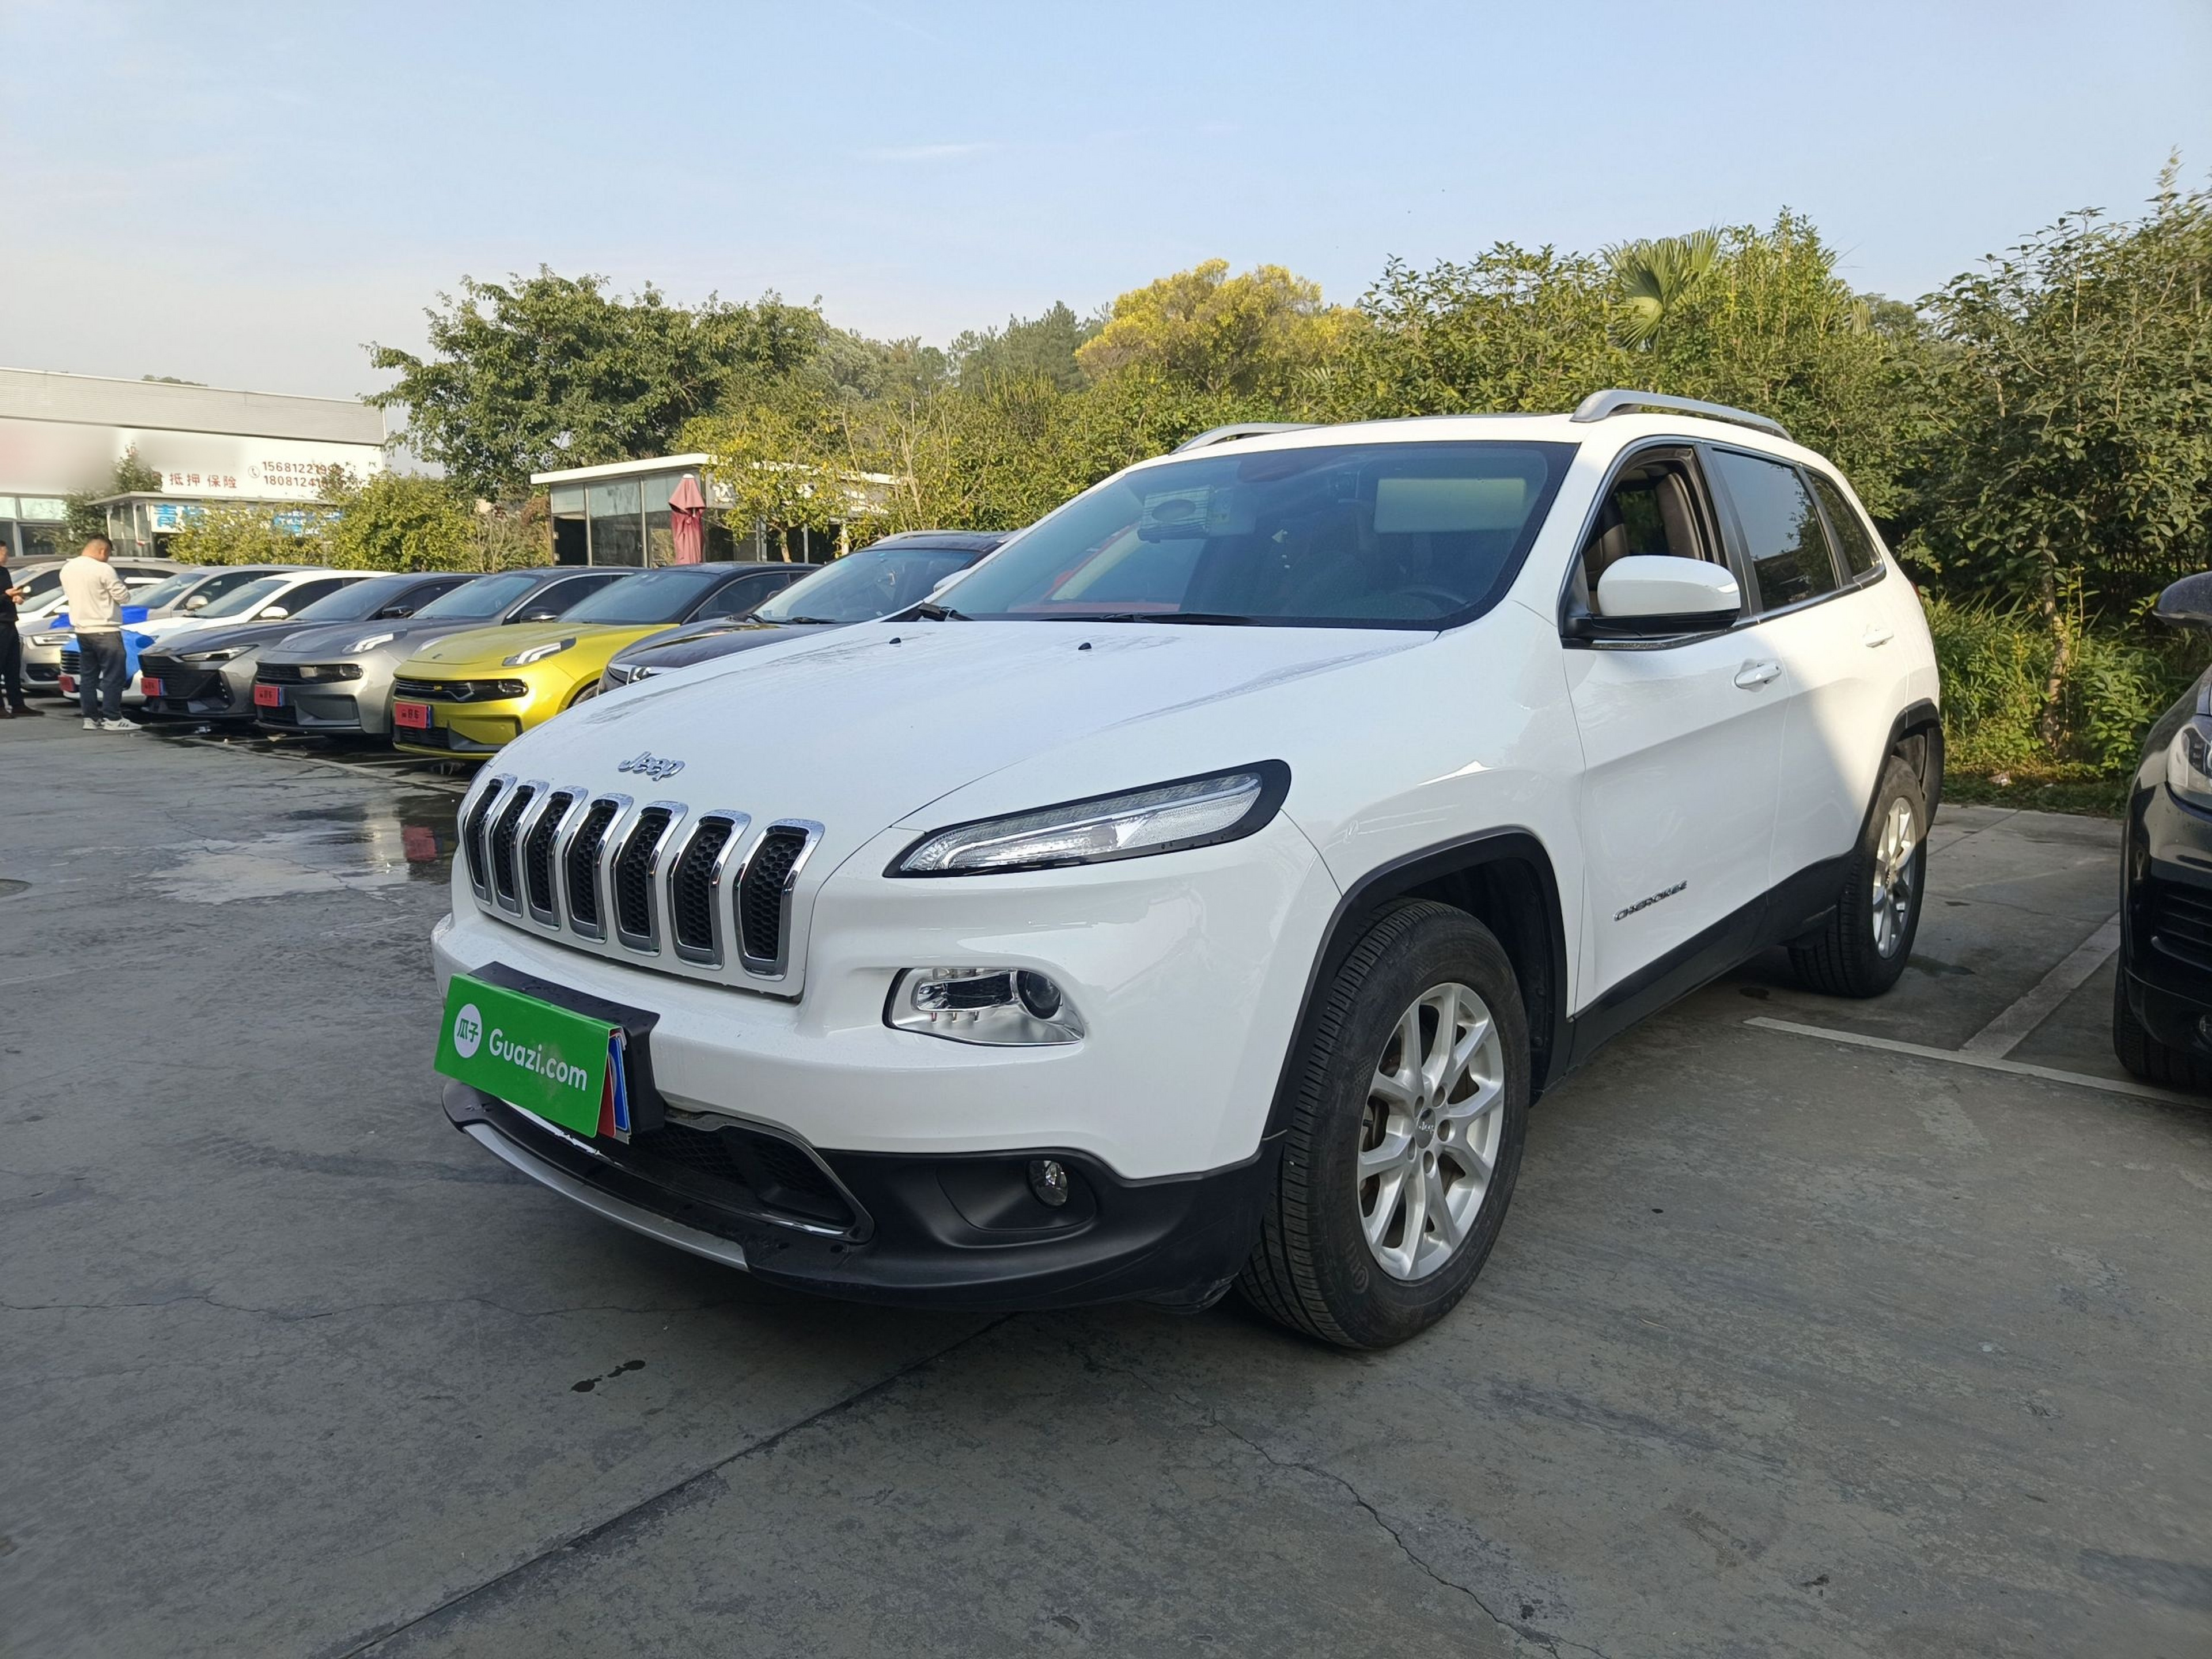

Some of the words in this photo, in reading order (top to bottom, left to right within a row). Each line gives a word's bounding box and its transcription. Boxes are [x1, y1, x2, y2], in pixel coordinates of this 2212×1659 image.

[169, 472, 200, 487] 抵押
[207, 475, 237, 488] 保险
[618, 751, 685, 781] Jeep
[457, 1018, 479, 1043] 瓜子
[489, 1028, 588, 1091] Guazi.com
